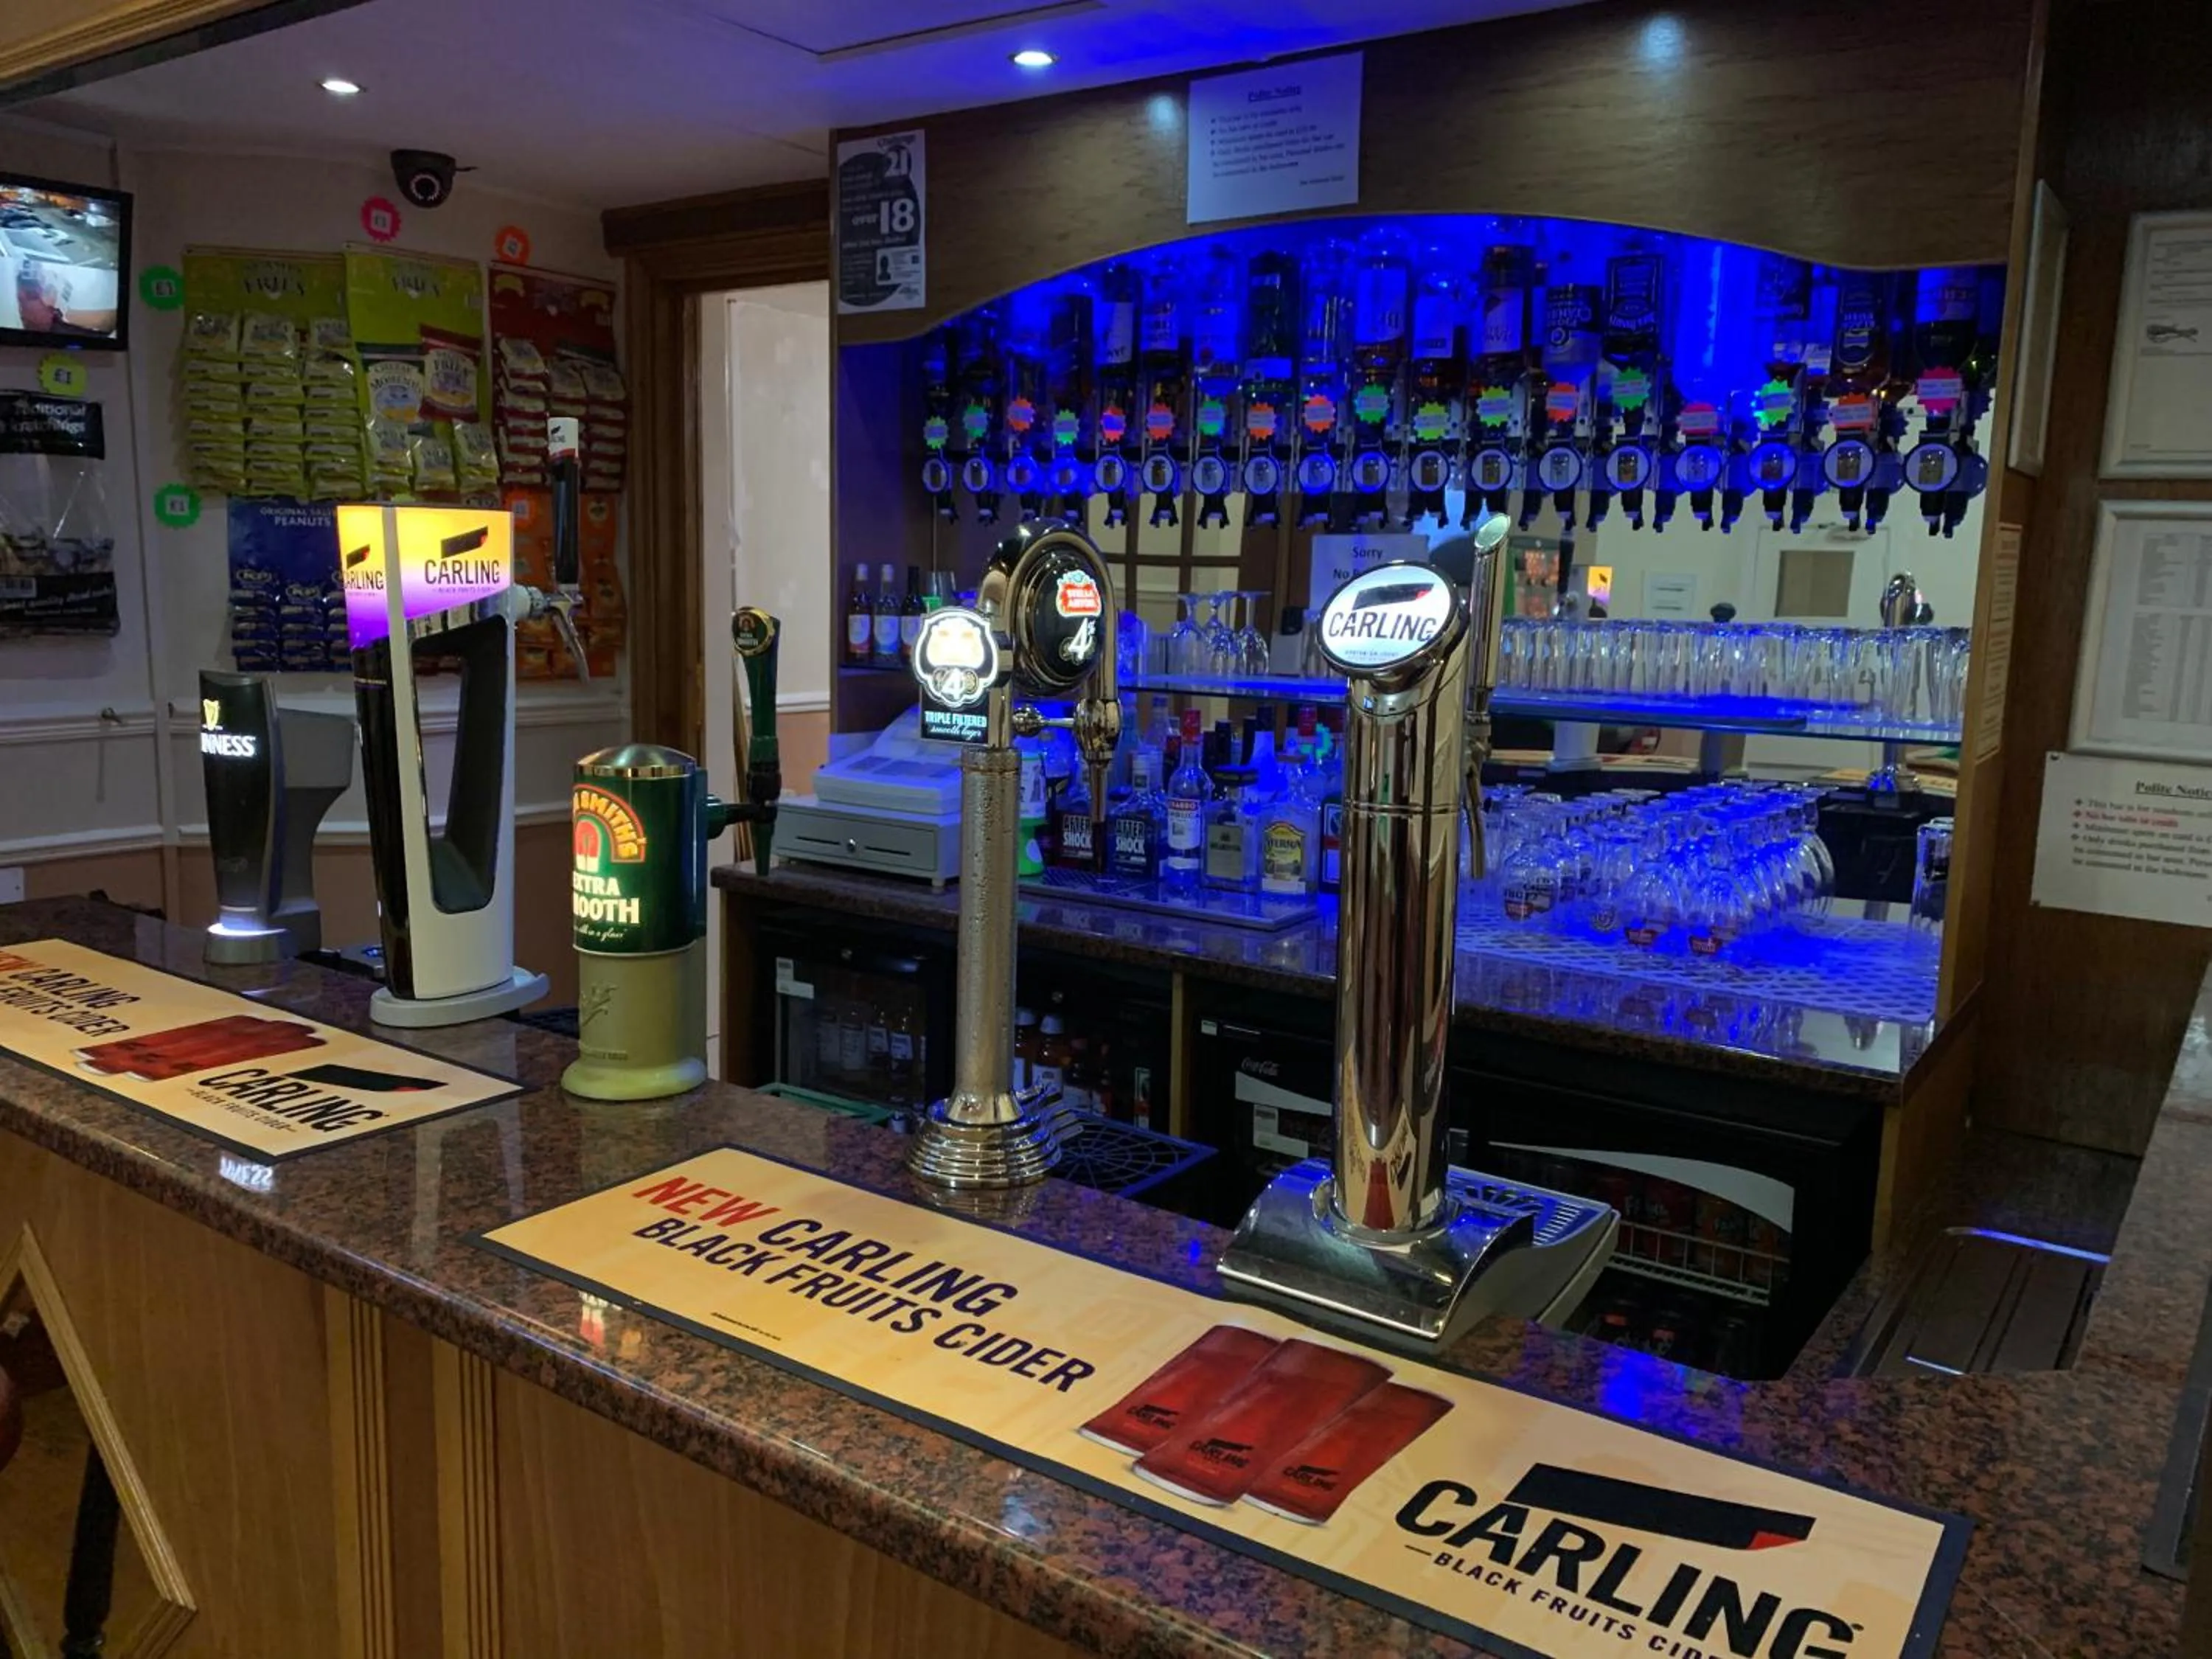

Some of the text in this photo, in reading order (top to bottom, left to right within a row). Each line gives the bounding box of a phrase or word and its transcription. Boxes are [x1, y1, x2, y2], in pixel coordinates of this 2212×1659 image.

[886, 148, 910, 177] 21
[852, 212, 879, 226] over
[880, 197, 915, 234] 18
[274, 516, 332, 526] PEANUTS
[1352, 546, 1383, 560] Sorry
[424, 559, 500, 585] CARLING
[1333, 568, 1349, 580] No
[1329, 612, 1437, 643] CARLING
[925, 710, 988, 728] TRIPLE FILTERED
[2135, 779, 2171, 794] Polite
[1062, 832, 1093, 849] SHOCK
[1115, 836, 1145, 854] SHOCK
[573, 891, 640, 924] OOTH
[8, 968, 141, 1009] CARLING
[0, 987, 131, 1037] RUITS CIDER
[198, 1068, 383, 1133] CARLING
[632, 1176, 1019, 1318] NEW CARLING
[631, 1217, 783, 1277] BLACK
[765, 1262, 942, 1336] FRUITS
[933, 1321, 1097, 1394] CIDER
[1189, 1440, 1251, 1469] CARLING
[1394, 1478, 1855, 1659] CARLING
[1433, 1552, 1724, 1659] BLACK FRUITS CID
